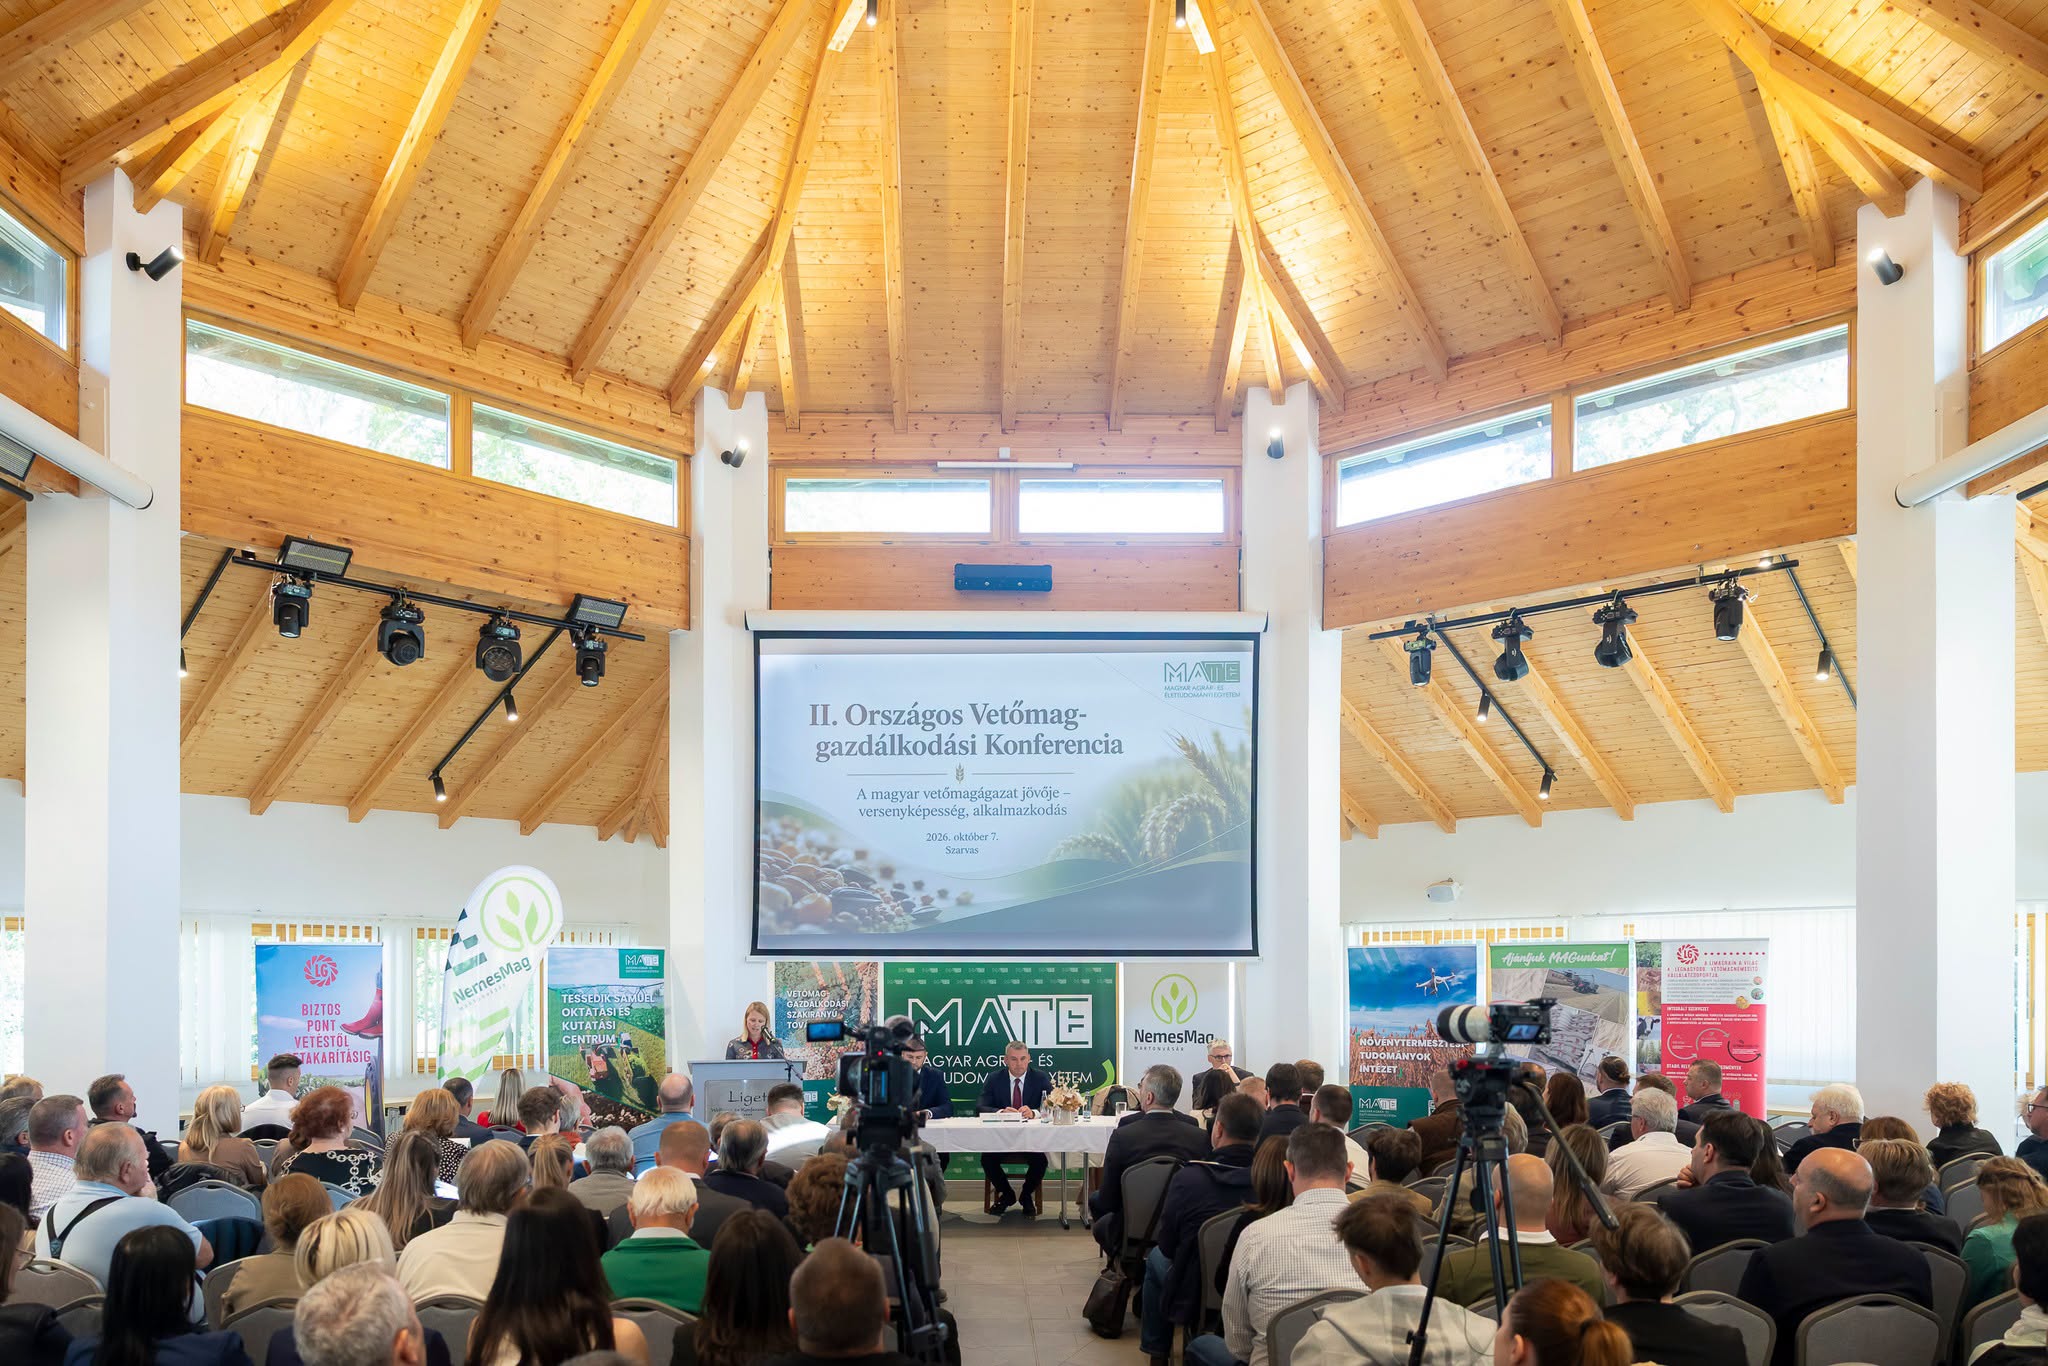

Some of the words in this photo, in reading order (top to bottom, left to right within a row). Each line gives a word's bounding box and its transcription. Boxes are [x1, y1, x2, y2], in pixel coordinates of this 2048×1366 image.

[1164, 661, 1241, 683] MATE
[809, 703, 838, 726] II.
[845, 701, 963, 732] Országos
[968, 699, 1087, 731] Vetőmag-
[815, 732, 977, 763] gazdálkodási
[984, 732, 1124, 756] Konferencia
[856, 788, 867, 800] A
[871, 790, 920, 803] magyar
[923, 786, 1018, 803] vetőmagágazat
[1020, 786, 1060, 802] jövője
[859, 804, 969, 820] versenyképesség,
[973, 803, 1068, 817] alkalmazkodás
[925, 832, 951, 842] 2026.
[953, 832, 989, 841] október
[990, 832, 999, 841] 7.
[945, 845, 979, 855] Szarvas
[1501, 951, 1545, 967] Ajánljuk
[1548, 947, 1617, 964] MAGunkat!
[1683, 949, 1693, 959] LG
[315, 963, 329, 978] LG
[562, 994, 611, 1004] TESSEDIK
[302, 1004, 341, 1016] BIZTOS
[561, 1004, 616, 1017] OKTATÁSI
[618, 1004, 631, 1016] ÉS
[307, 1019, 336, 1032] PONT
[562, 1019, 616, 1031] KUTATÁSI
[908, 995, 1092, 1048] MATE
[294, 1033, 349, 1048] VETÉSTŐL
[562, 1034, 615, 1045] CENTRUM
[1134, 1029, 1214, 1045] NemesMag
[292, 1049, 371, 1065] TAKARÍTÁSIG
[921, 1054, 971, 1067] AGYAR
[1038, 1050, 1054, 1067] ÉS
[1360, 1051, 1431, 1061] TUDOMÁNYOK
[1359, 1063, 1398, 1074] INTÉZET
[1049, 1070, 1093, 1084] YETEM
[1359, 1098, 1397, 1110] MATE
